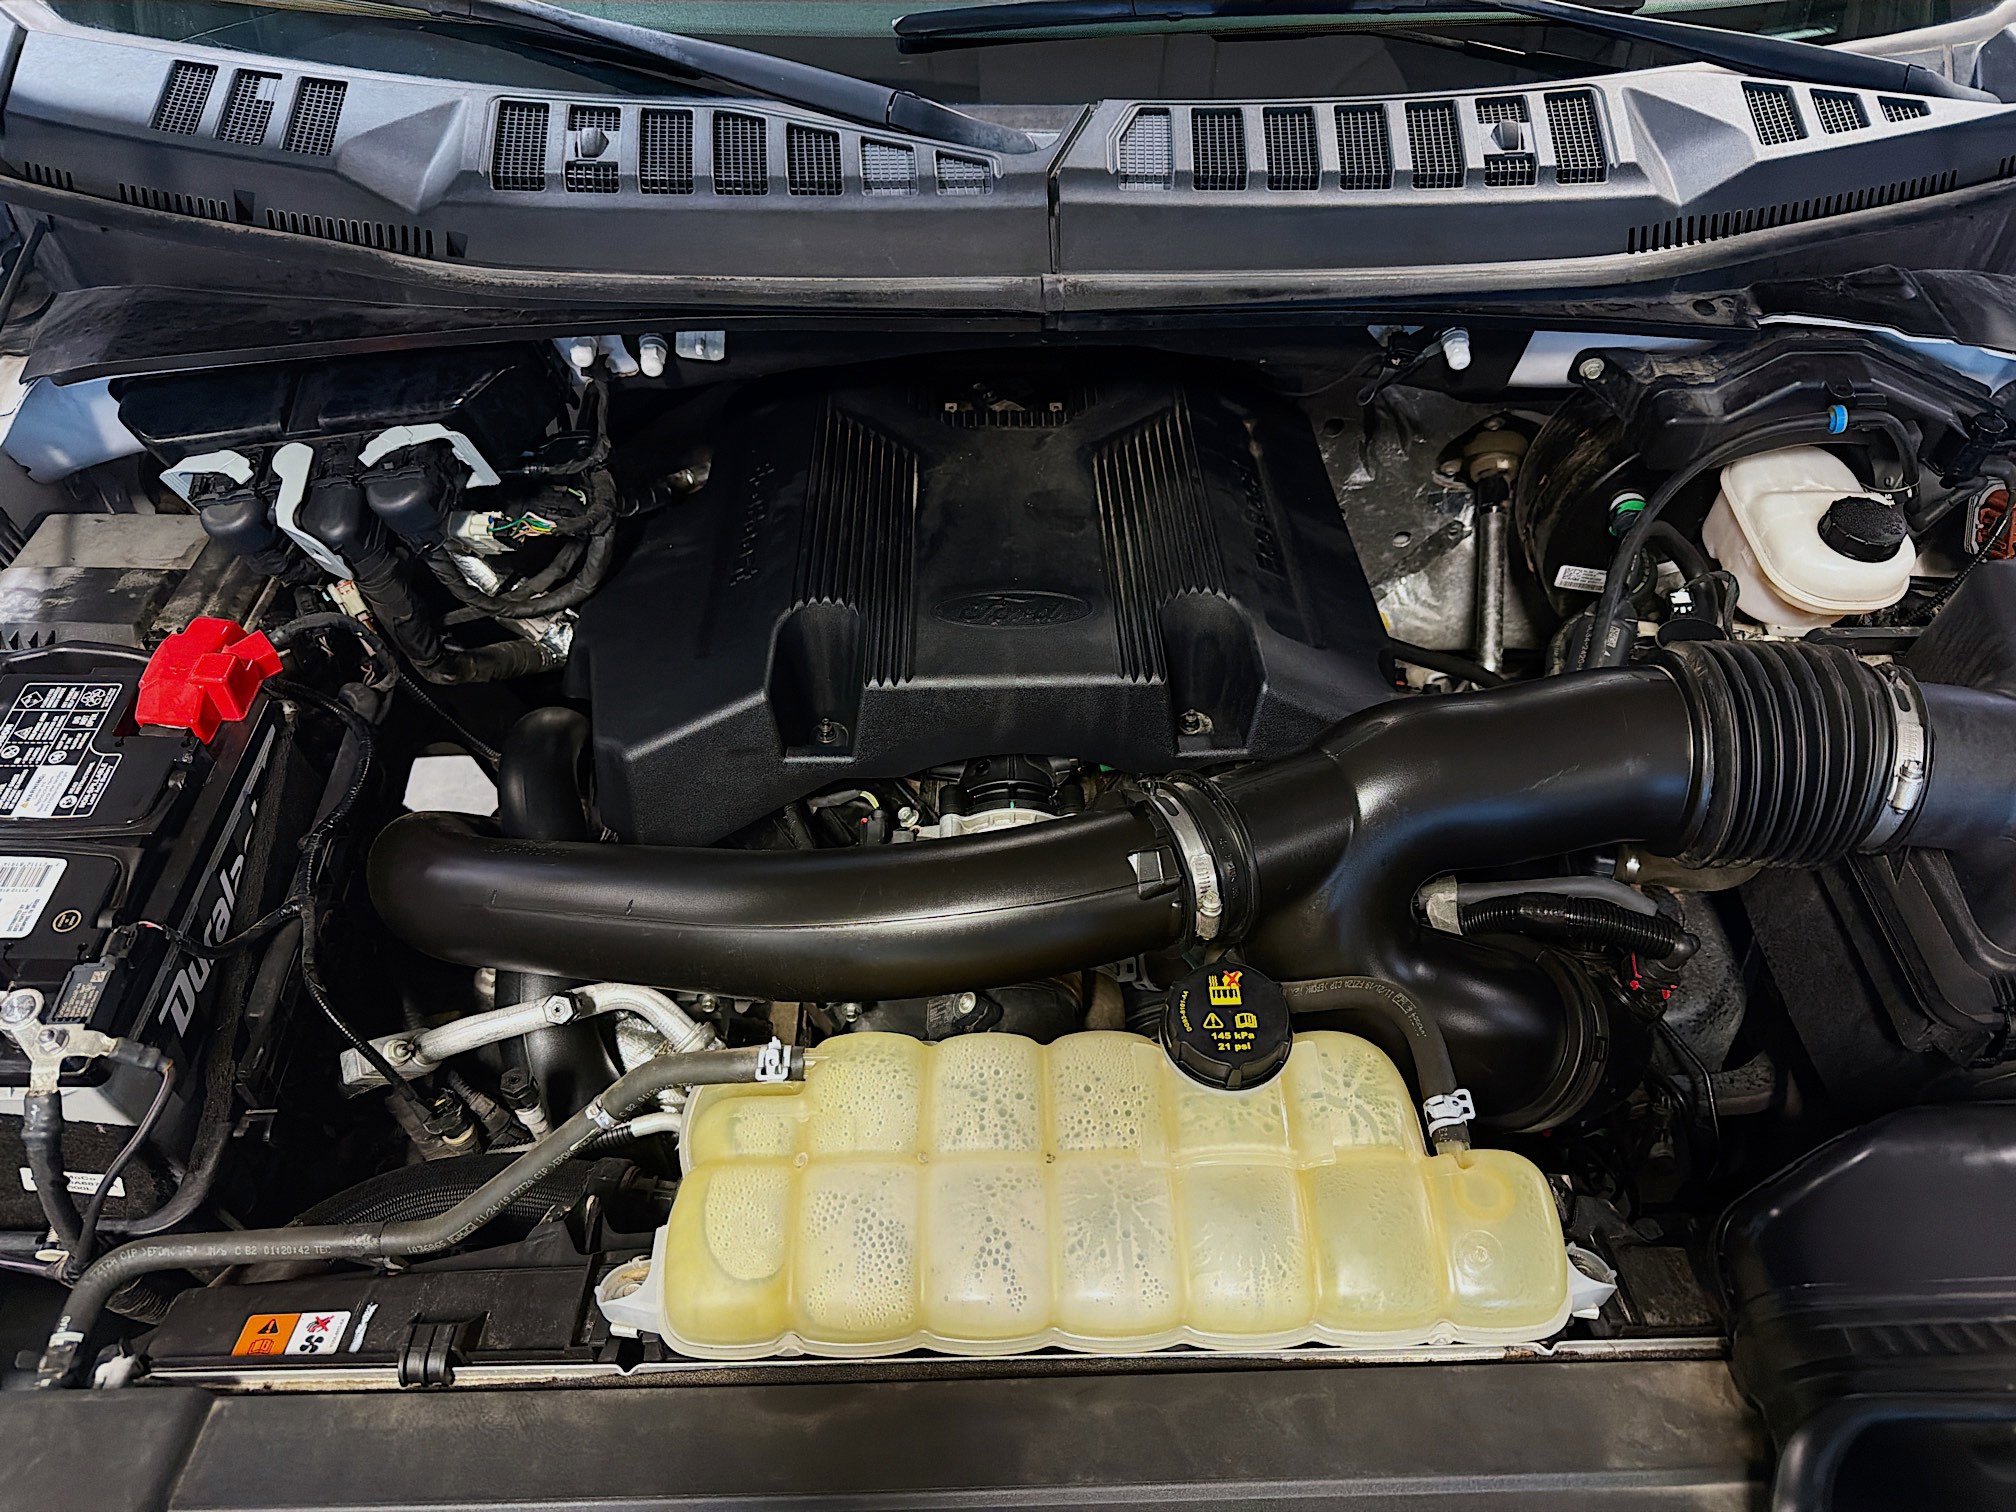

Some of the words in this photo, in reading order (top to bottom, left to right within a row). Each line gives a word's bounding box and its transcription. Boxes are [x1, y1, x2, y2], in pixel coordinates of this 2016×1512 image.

[950, 594, 1072, 627] Ford
[1211, 1032, 1231, 1040] 145
[1234, 1032, 1255, 1040] kPa
[1234, 1044, 1251, 1052] psi
[475, 1196, 511, 1223] 11/24/19
